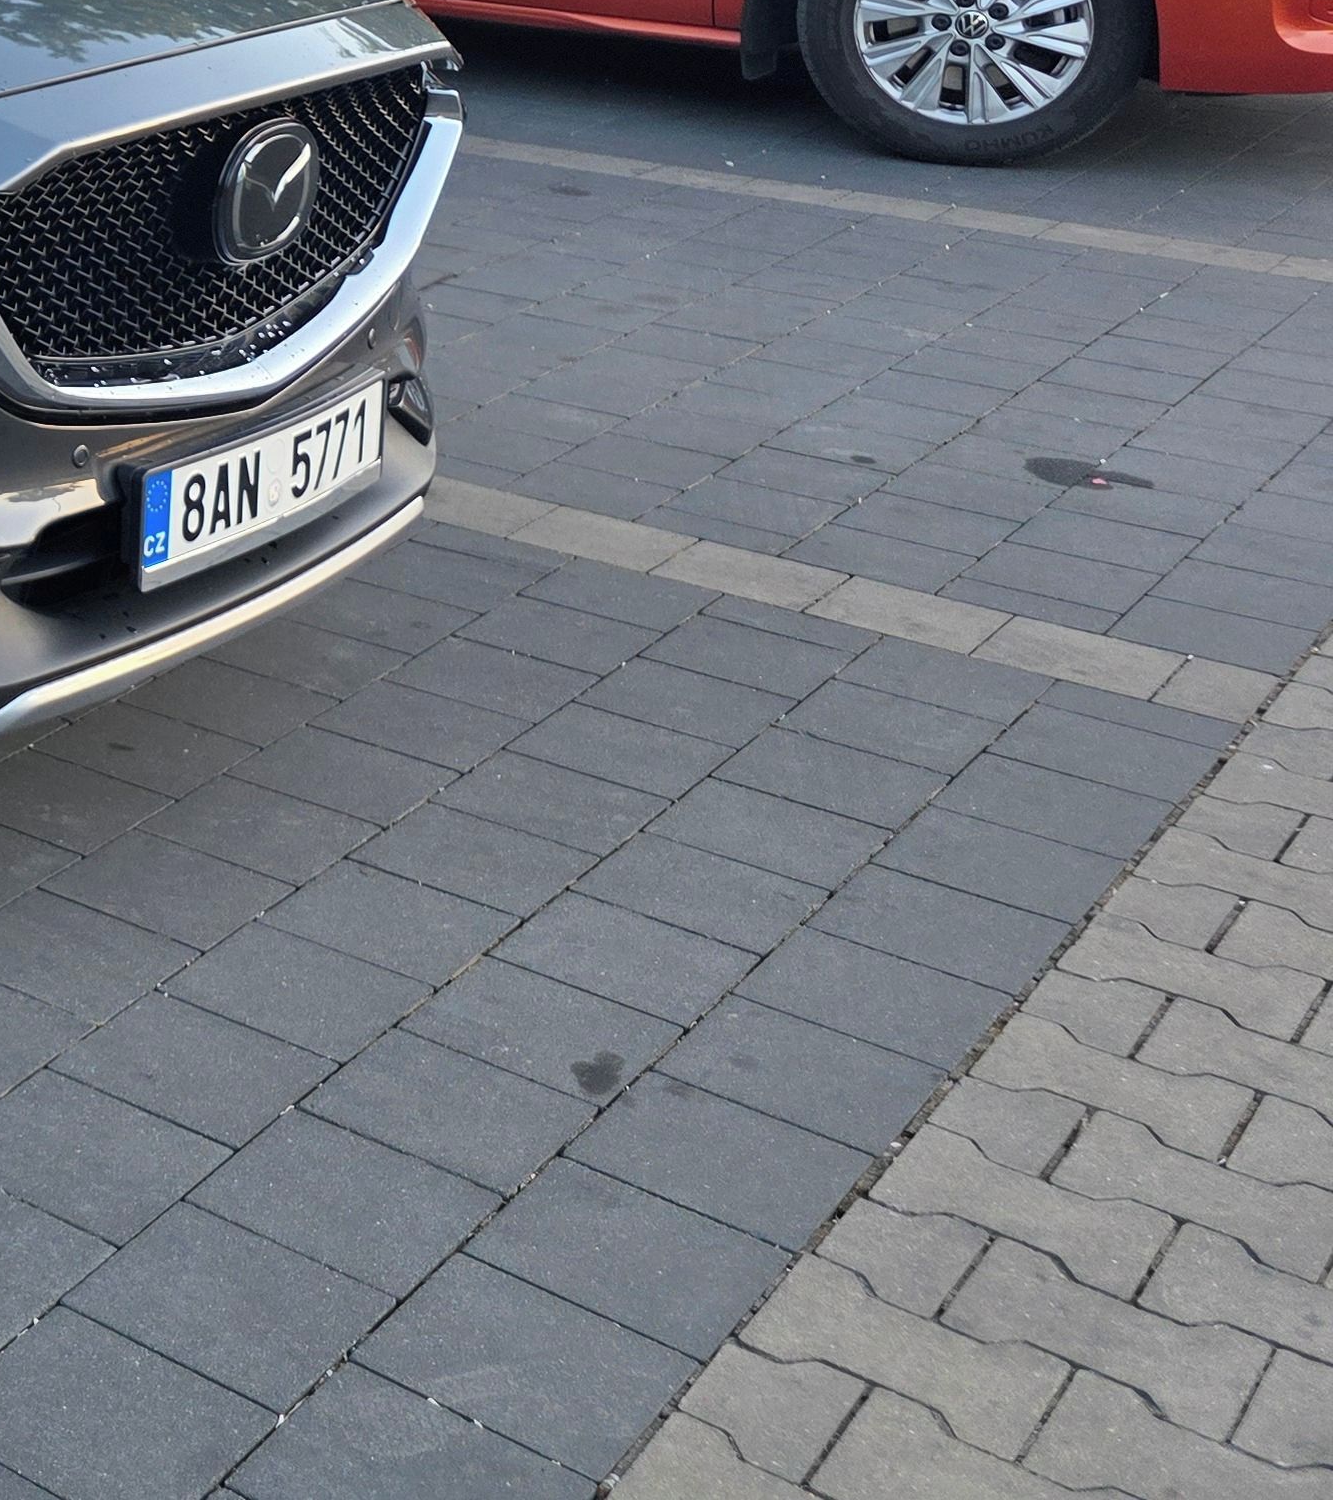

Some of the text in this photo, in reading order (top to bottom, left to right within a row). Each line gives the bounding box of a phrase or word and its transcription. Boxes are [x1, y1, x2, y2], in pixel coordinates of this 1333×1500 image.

[180, 397, 369, 543] 8AN 5771
[143, 529, 167, 558] CZ
